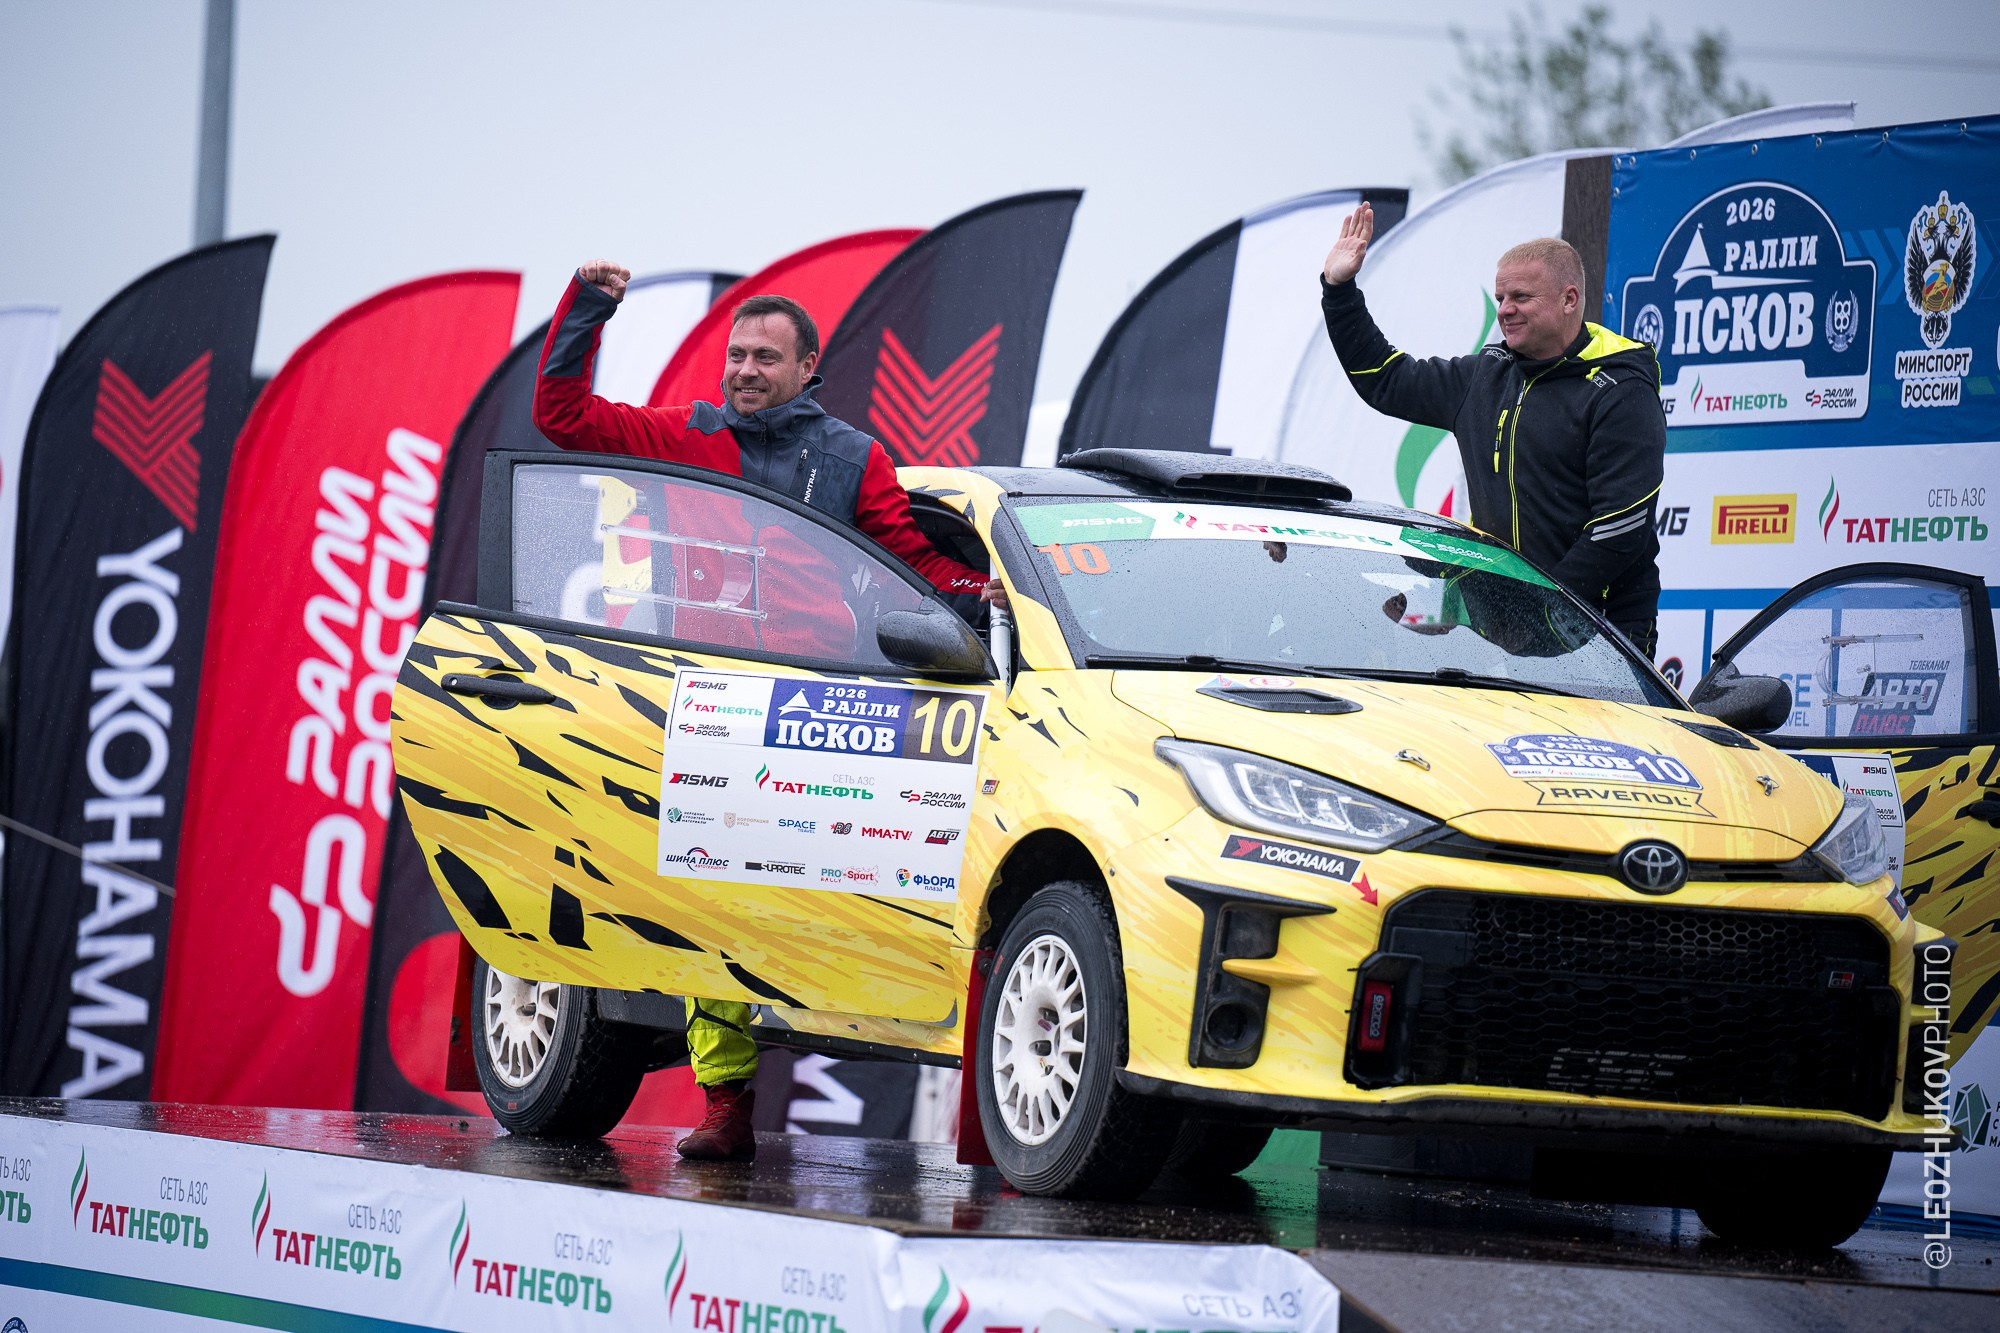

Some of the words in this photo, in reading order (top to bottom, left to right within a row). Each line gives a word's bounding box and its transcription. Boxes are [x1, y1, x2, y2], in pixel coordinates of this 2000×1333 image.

[1726, 198, 1776, 226] 2026
[1723, 235, 1818, 273] РАЛЛИ
[1671, 291, 1815, 356] ПСКОВ
[1898, 352, 1970, 375] МИНСПОРТ
[1704, 393, 1788, 413] ТАТНЕФТЬ
[1823, 388, 1853, 398] РАЛЛИ
[1904, 382, 1959, 403] РОССИИ
[1821, 398, 1857, 409] РОССИИ
[804, 468, 817, 503] INNTRAIL
[1928, 488, 1958, 508] СЕТЬ
[1961, 487, 1986, 507] АЗС
[1718, 503, 1790, 535] PIRELLI
[1842, 516, 1989, 543] ТАТНЕФТЬ
[1208, 523, 1393, 547] ТАТНЕФТЬ
[1037, 543, 1111, 575] 10
[287, 466, 375, 798] РАЛЛИ
[1909, 660, 1950, 671] ТЕЛЕКАНАЛ
[691, 681, 728, 690] ASMG
[824, 686, 867, 699] 2026
[1861, 679, 1938, 710] АВТО
[694, 704, 763, 716] ТАТНЕФТЬ
[821, 699, 901, 718] РАЛЛИ
[694, 729, 730, 737] РОССИИ
[697, 723, 727, 731] РАЛЛИ
[914, 696, 976, 757] 10
[1855, 713, 1910, 734] ПЛЮС
[775, 719, 896, 753] ПСКОВ
[1541, 741, 1616, 753] РАЛЛИ
[1520, 751, 1636, 770] ПСКОВ
[1635, 756, 1691, 783] 10
[677, 773, 729, 788] ASMG
[832, 773, 855, 784] СЕТЬ
[856, 776, 875, 786] АЗС
[772, 781, 874, 800] ТАТНЕФТЬ
[922, 791, 962, 801] РАЛЛИ
[1550, 787, 1692, 808] RAVENOL
[1850, 788, 1893, 798] ТАТНЕФТЬ
[61, 527, 183, 1099] YOKOHAMA
[919, 799, 966, 809] РОССИИ
[778, 818, 816, 830] SPACE
[929, 830, 958, 840] АВТО
[666, 854, 696, 864] ШИНА
[699, 857, 730, 867] ПЛЮС
[760, 862, 806, 875] SUPROTEC
[1260, 844, 1345, 876] YOKOHAMA
[913, 874, 955, 890] ФЬОРД
[1370, 994, 1384, 1038] sparco
[11, 1158, 32, 1181] АЗС
[160, 1176, 186, 1201] СЕТЬ
[187, 1180, 208, 1206] АЗС
[89, 1201, 209, 1250] ТАТНЕФТЬ
[348, 1203, 377, 1230] СЕТЬ
[379, 1208, 402, 1234] АЗС
[272, 1228, 402, 1281] ТАТНЕФТЬ
[554, 1232, 583, 1262] СЕТЬ
[585, 1238, 613, 1266] АЗС
[471, 1258, 612, 1314] ТАТНЕФТЬ
[781, 1266, 815, 1297] СЕТЬ
[817, 1273, 847, 1302] АЗС
[1184, 1293, 1253, 1319] СЕТЬ
[1263, 1290, 1302, 1319] АЗ
